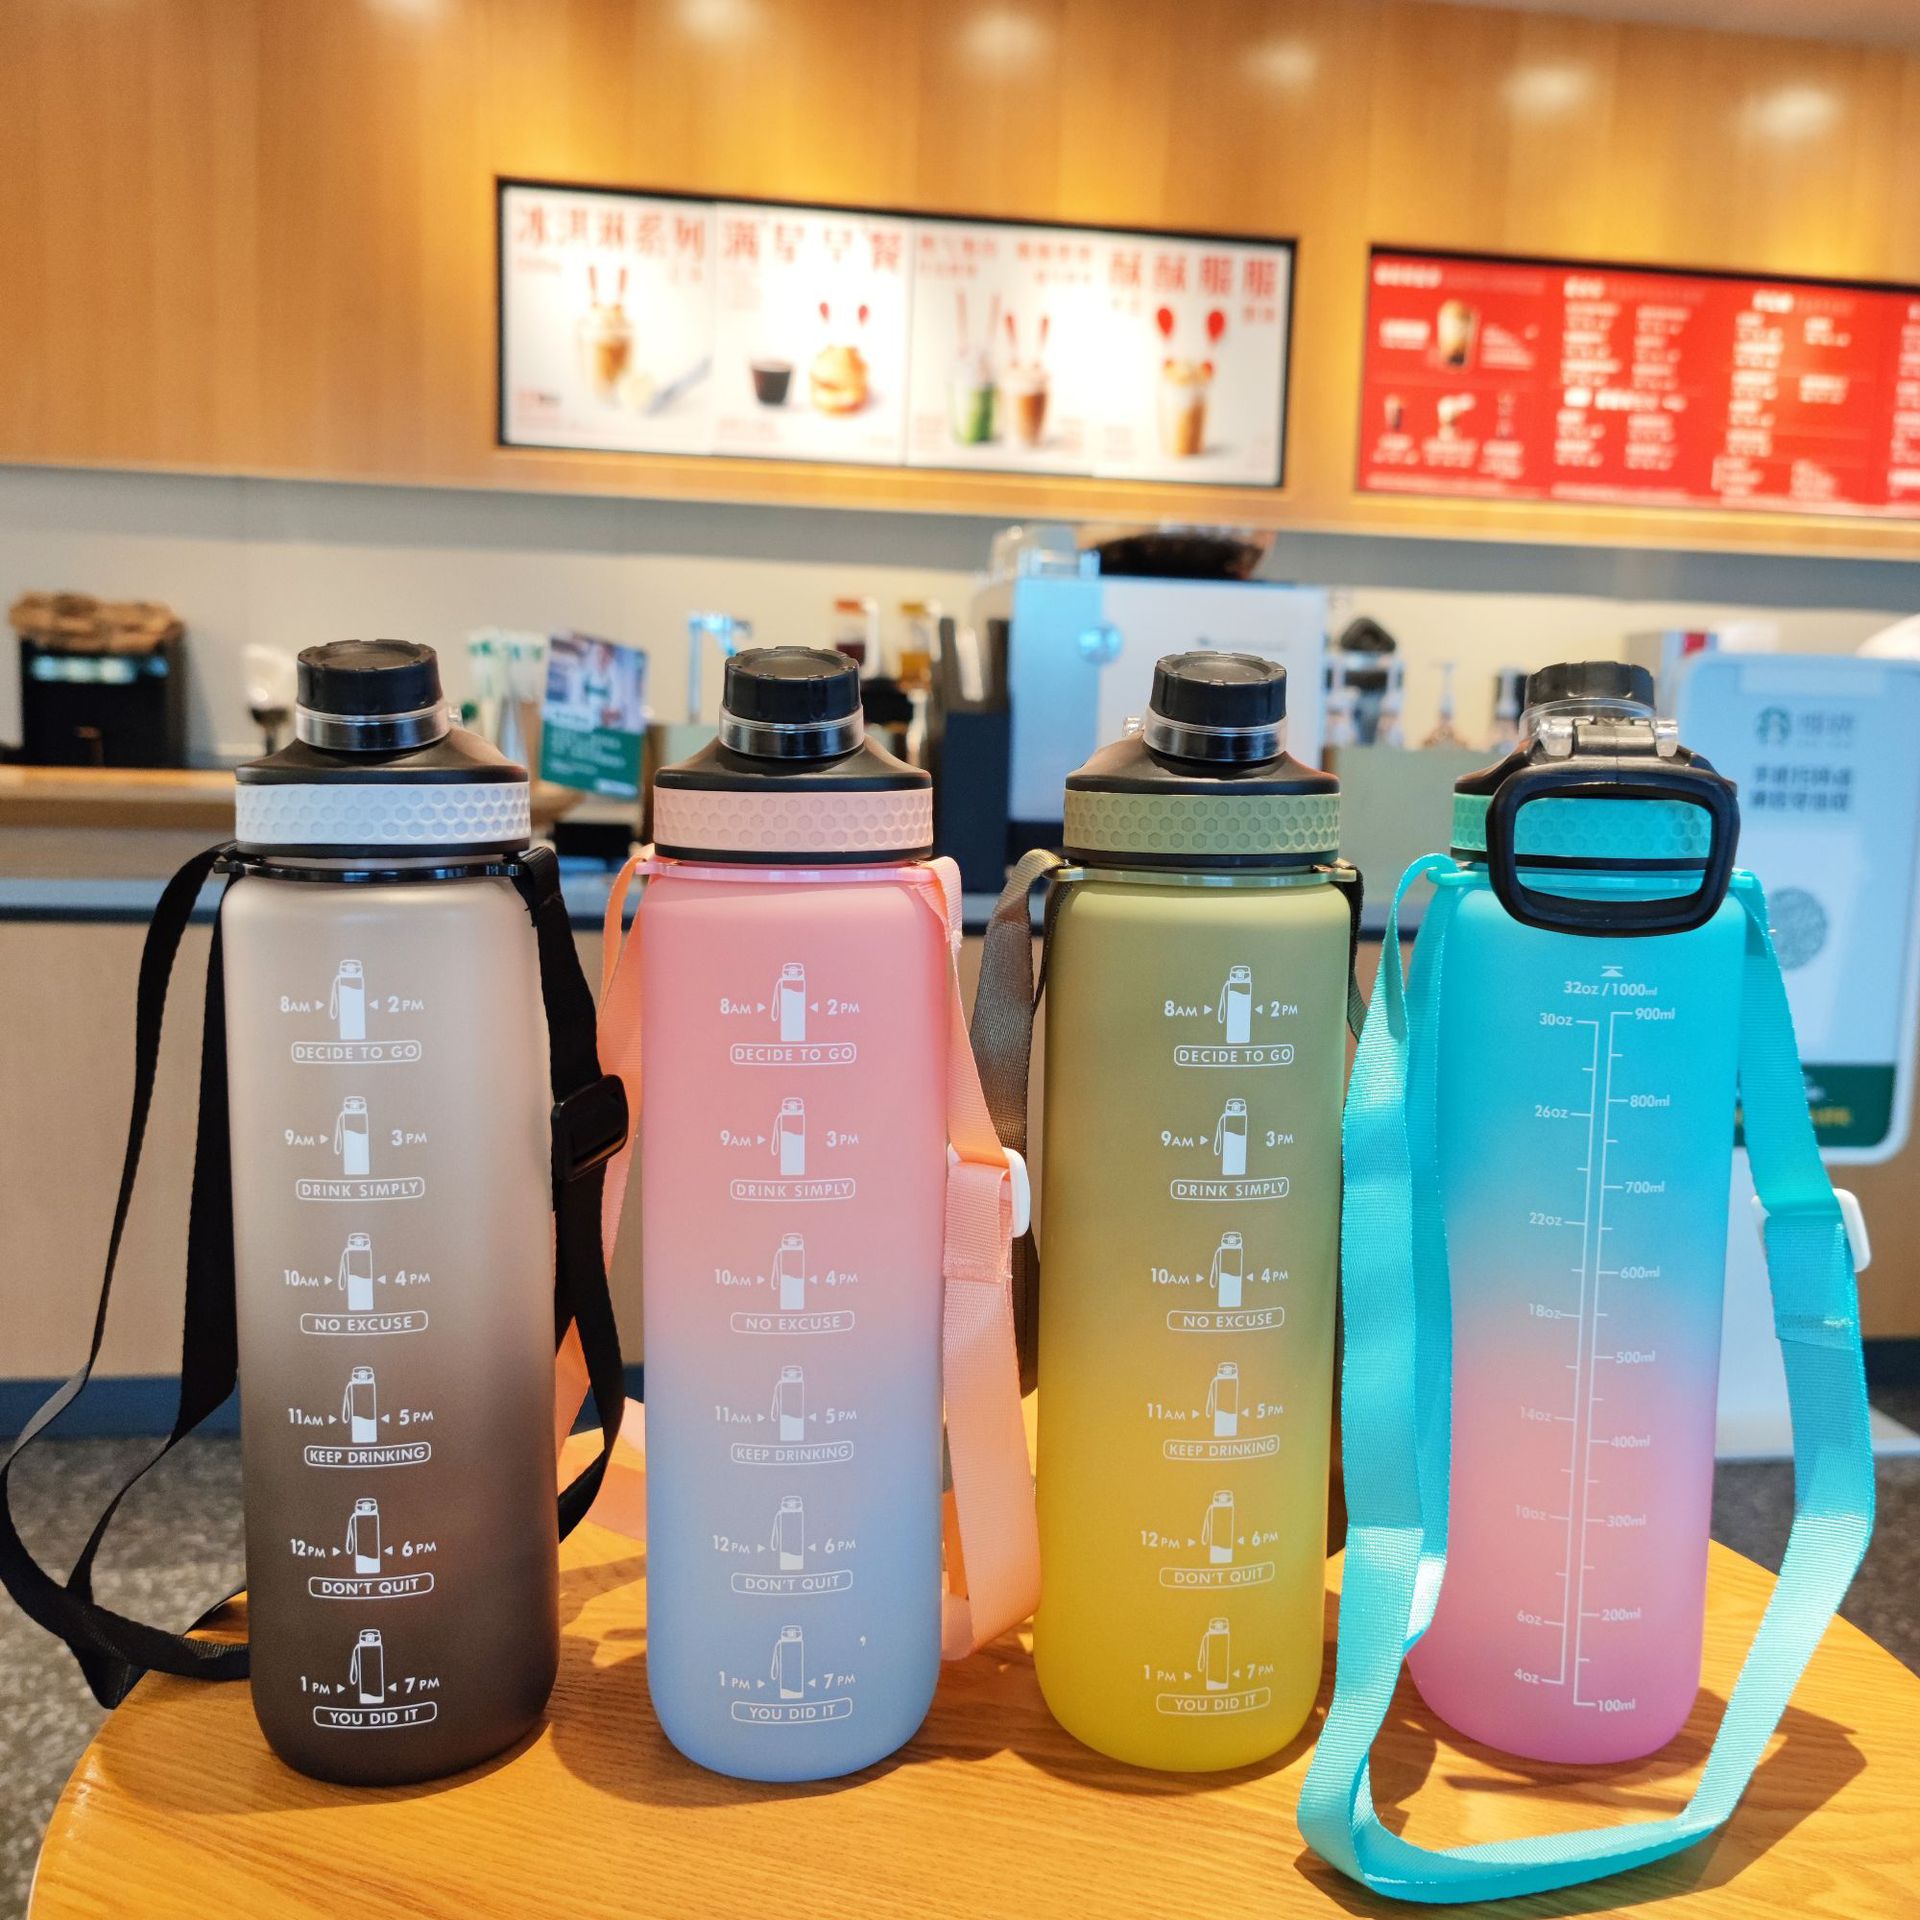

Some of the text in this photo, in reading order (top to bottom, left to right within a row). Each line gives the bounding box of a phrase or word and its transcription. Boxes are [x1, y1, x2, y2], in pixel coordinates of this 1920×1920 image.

[280, 996, 311, 1013] 8AM
[720, 998, 752, 1014] 8AM
[1164, 1001, 1198, 1017] 8AM
[1539, 1013, 1572, 1026] 30oz
[1635, 1008, 1675, 1020] 900ml
[296, 1045, 417, 1059] DECIDE TO GO
[735, 1047, 853, 1061] DECIDE TO GO
[1179, 1049, 1291, 1063] DECIDE TO GO
[1630, 1095, 1670, 1107] 800ml
[1535, 1105, 1568, 1119] 26oz
[284, 1129, 315, 1146] 9AM
[720, 1130, 751, 1146] 9AM
[1161, 1131, 1194, 1147] 9AM
[302, 1181, 418, 1196] DRINK SIMPLY
[736, 1182, 851, 1197] DRINK SIMPLY
[1177, 1181, 1285, 1196] DRINK SIMPLY
[1626, 1181, 1664, 1193] 700ml
[1530, 1212, 1562, 1226] 22oz
[284, 1270, 319, 1287] 10AM
[714, 1269, 751, 1287] 10AM
[1151, 1267, 1190, 1284] 10AM
[1620, 1266, 1660, 1279] 600ml
[1528, 1303, 1561, 1319] 18oz
[315, 1316, 412, 1331] NO EXCUSE
[746, 1316, 840, 1330] NO EXCUSE
[1183, 1312, 1273, 1328] NO EXCUSE
[1615, 1351, 1655, 1364] 500ml
[288, 1408, 323, 1426] 11AM
[715, 1406, 751, 1423] 11AM
[1147, 1403, 1185, 1421] 11AM
[1169, 1439, 1275, 1457] KEEP DRINKING
[1611, 1435, 1650, 1448] 400ml
[310, 1447, 425, 1463] KEEP DRINKING
[737, 1445, 849, 1461] KEEP DRINKING
[1607, 1515, 1646, 1527] 300ml
[802, 1575, 839, 1590] QUIT
[1230, 1567, 1265, 1583] QUIT
[378, 1579, 419, 1594] QUIT
[1517, 1611, 1542, 1626] 6oz
[1602, 1608, 1641, 1621] 200ml
[1514, 1668, 1539, 1683] 4oz
[1175, 1694, 1256, 1711] YOU DID IT
[1597, 1698, 1635, 1712] 100ml
[330, 1709, 418, 1725] YOU DID IT
[749, 1704, 836, 1720] YOU DID IT
